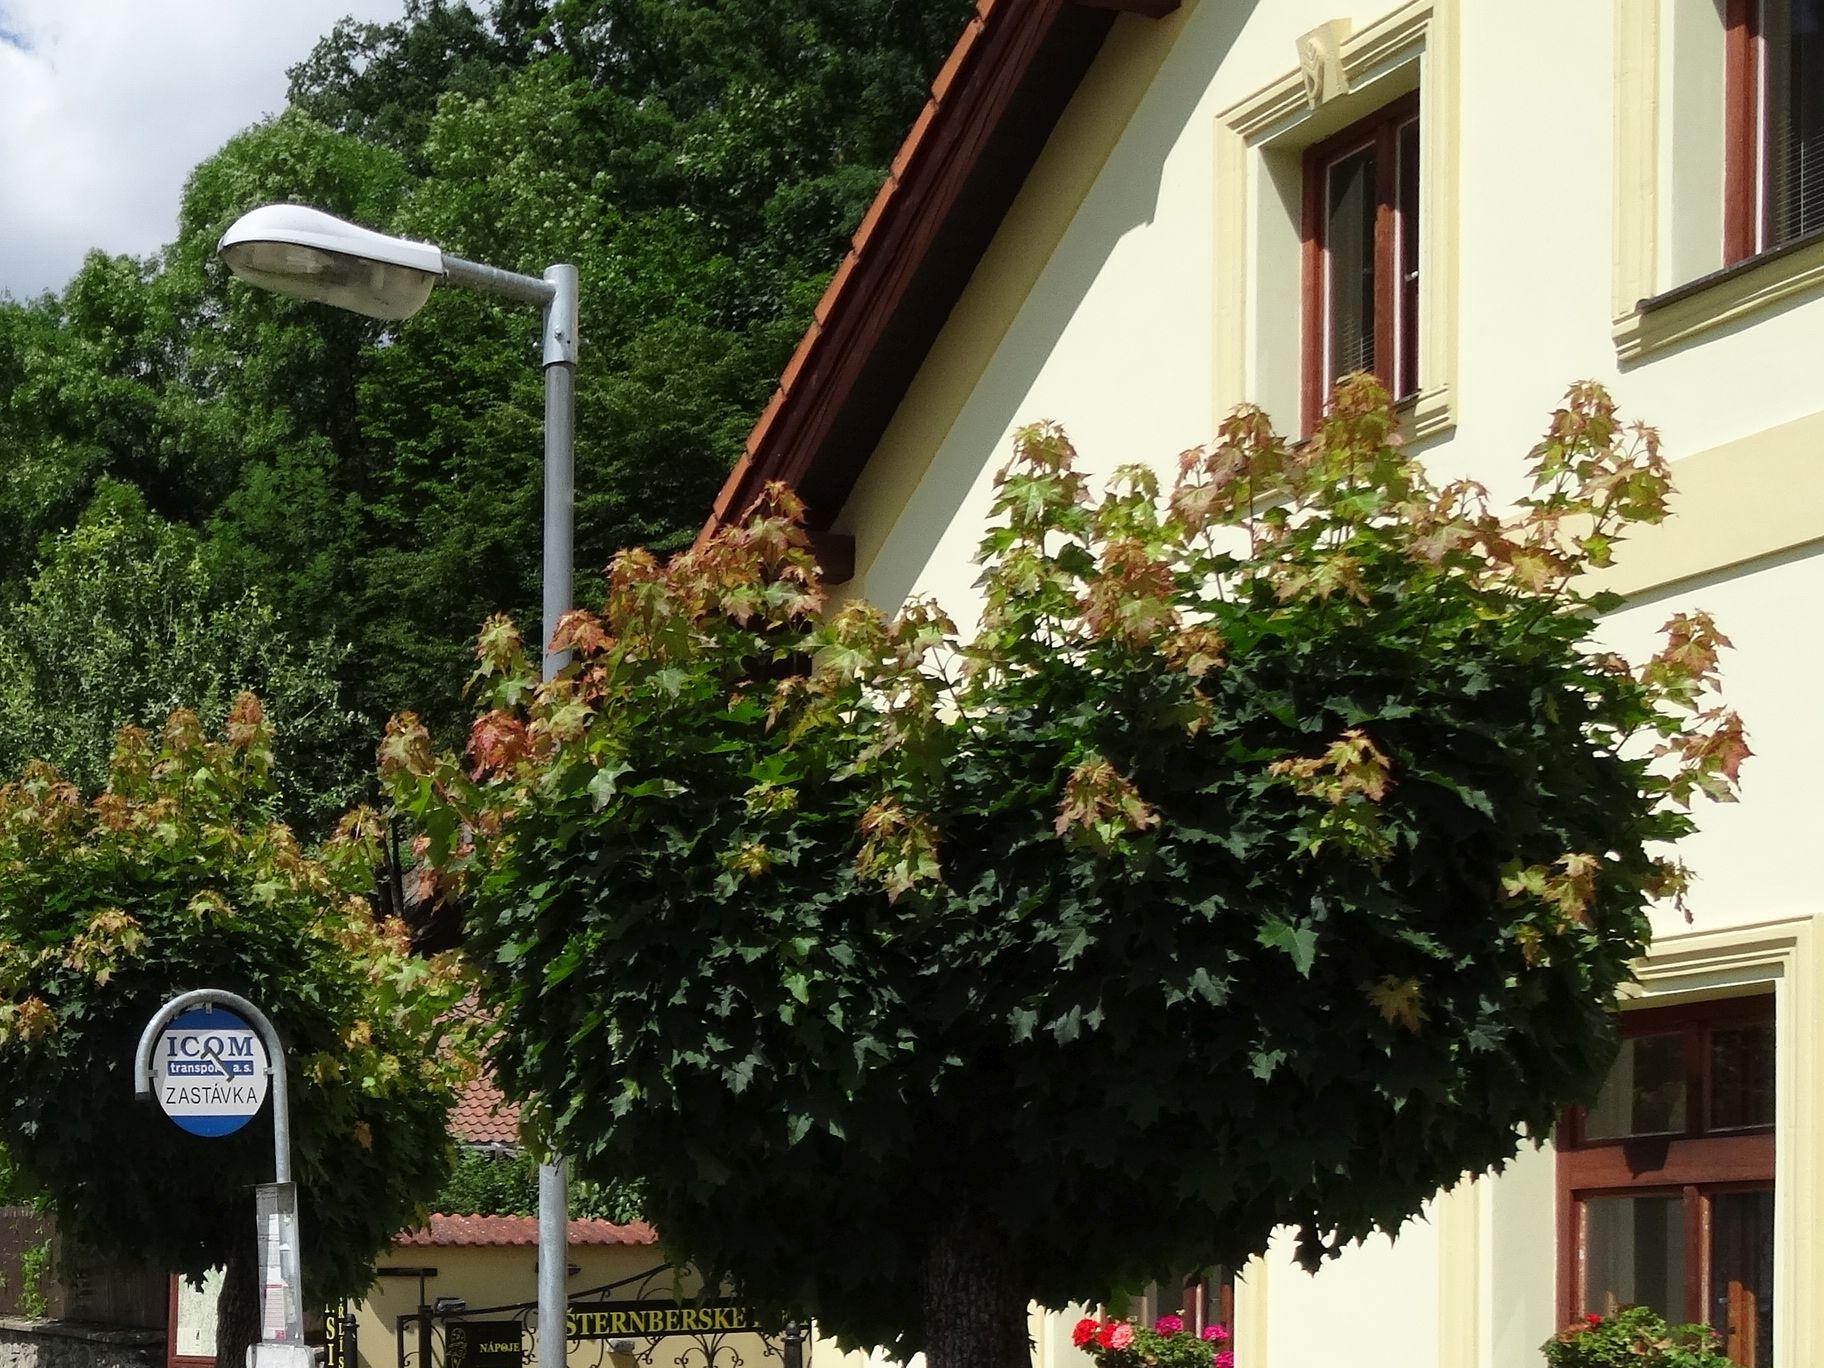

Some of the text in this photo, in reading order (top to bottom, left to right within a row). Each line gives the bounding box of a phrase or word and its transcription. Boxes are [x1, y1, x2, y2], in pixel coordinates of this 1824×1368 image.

[167, 1036, 254, 1057] ICOM
[170, 1063, 224, 1075] transpo
[166, 1083, 258, 1104] ZASTÁVKA
[479, 1341, 521, 1353] NÁPOJE
